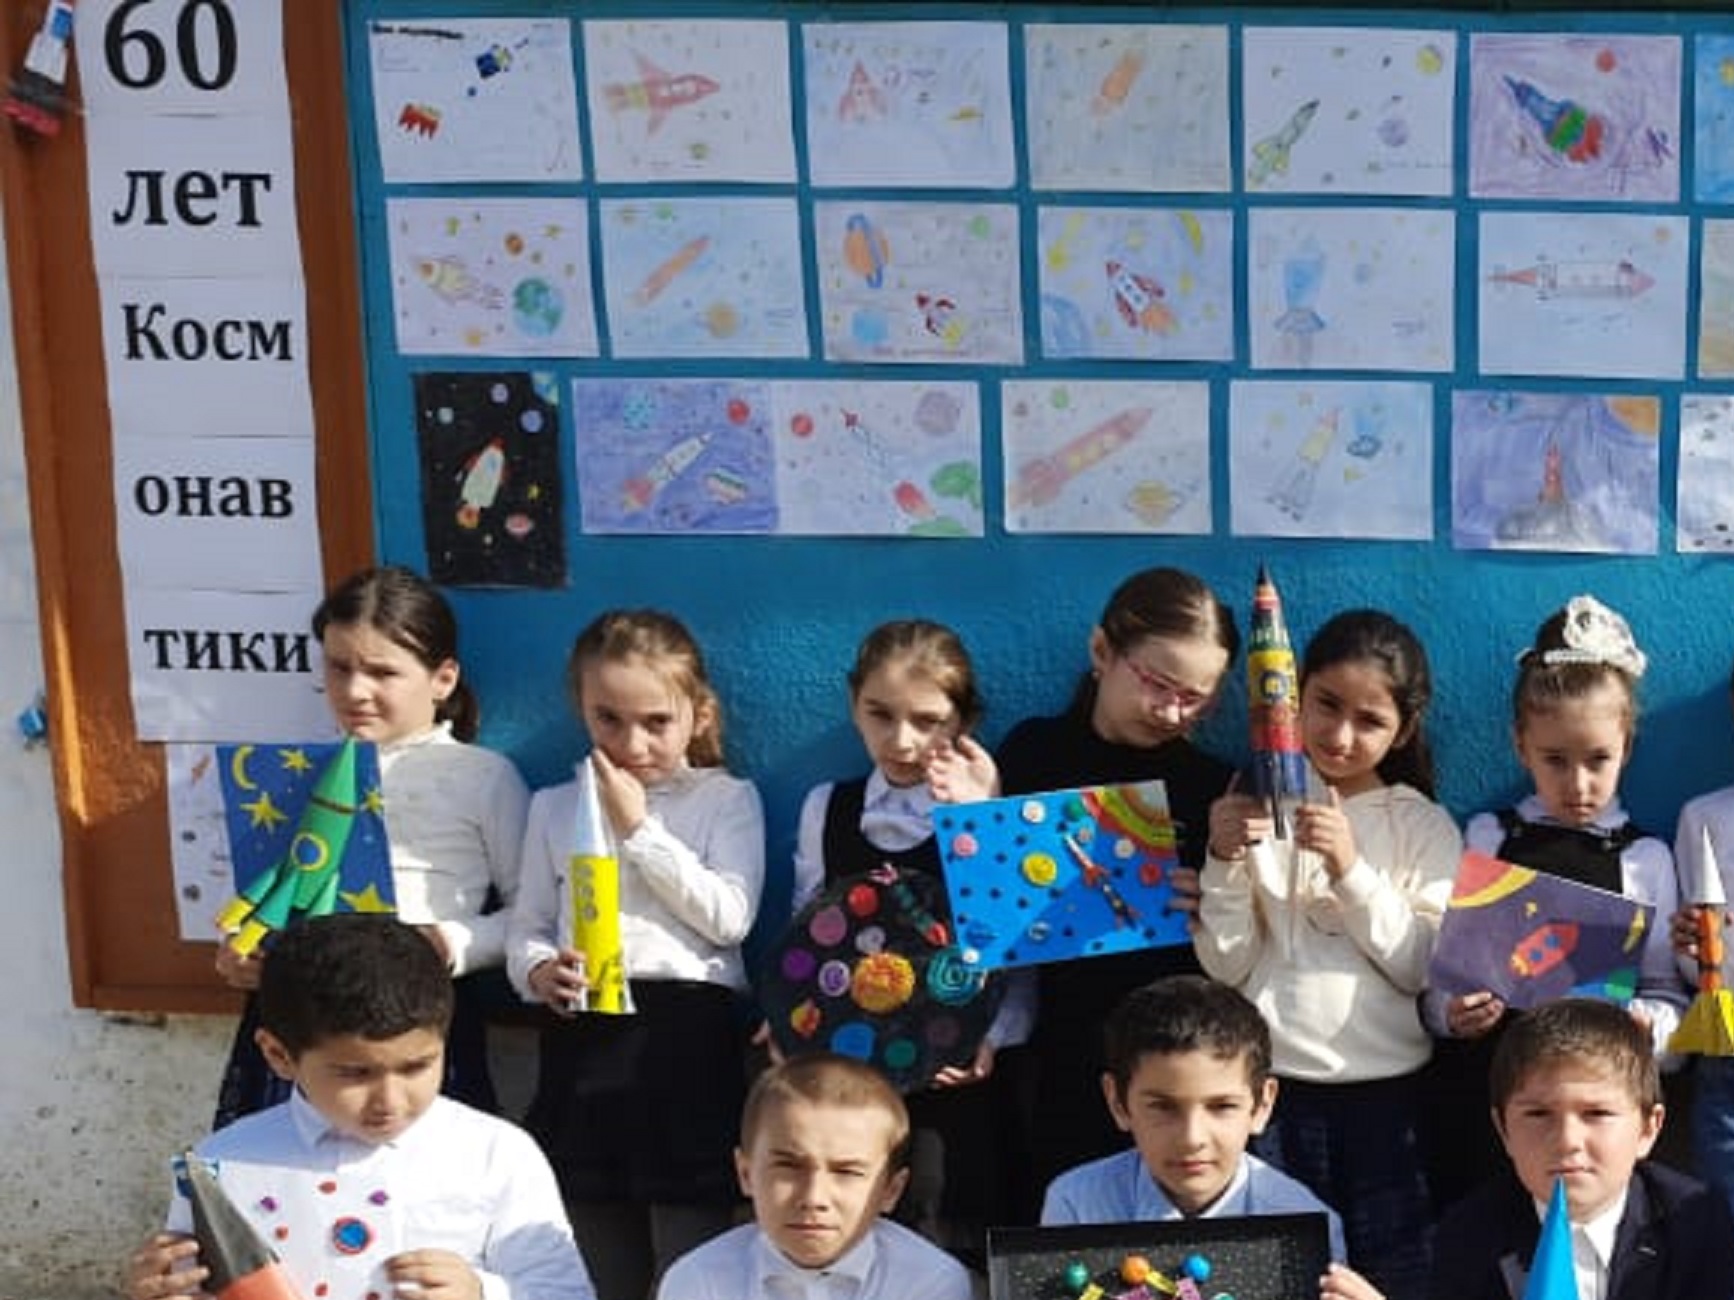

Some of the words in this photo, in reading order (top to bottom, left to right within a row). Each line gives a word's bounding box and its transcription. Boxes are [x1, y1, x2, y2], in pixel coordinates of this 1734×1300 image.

[104, 0, 238, 90] 60
[112, 170, 272, 227] лет
[121, 303, 293, 361] Косм
[134, 475, 293, 518] онав
[143, 629, 313, 673] тики
